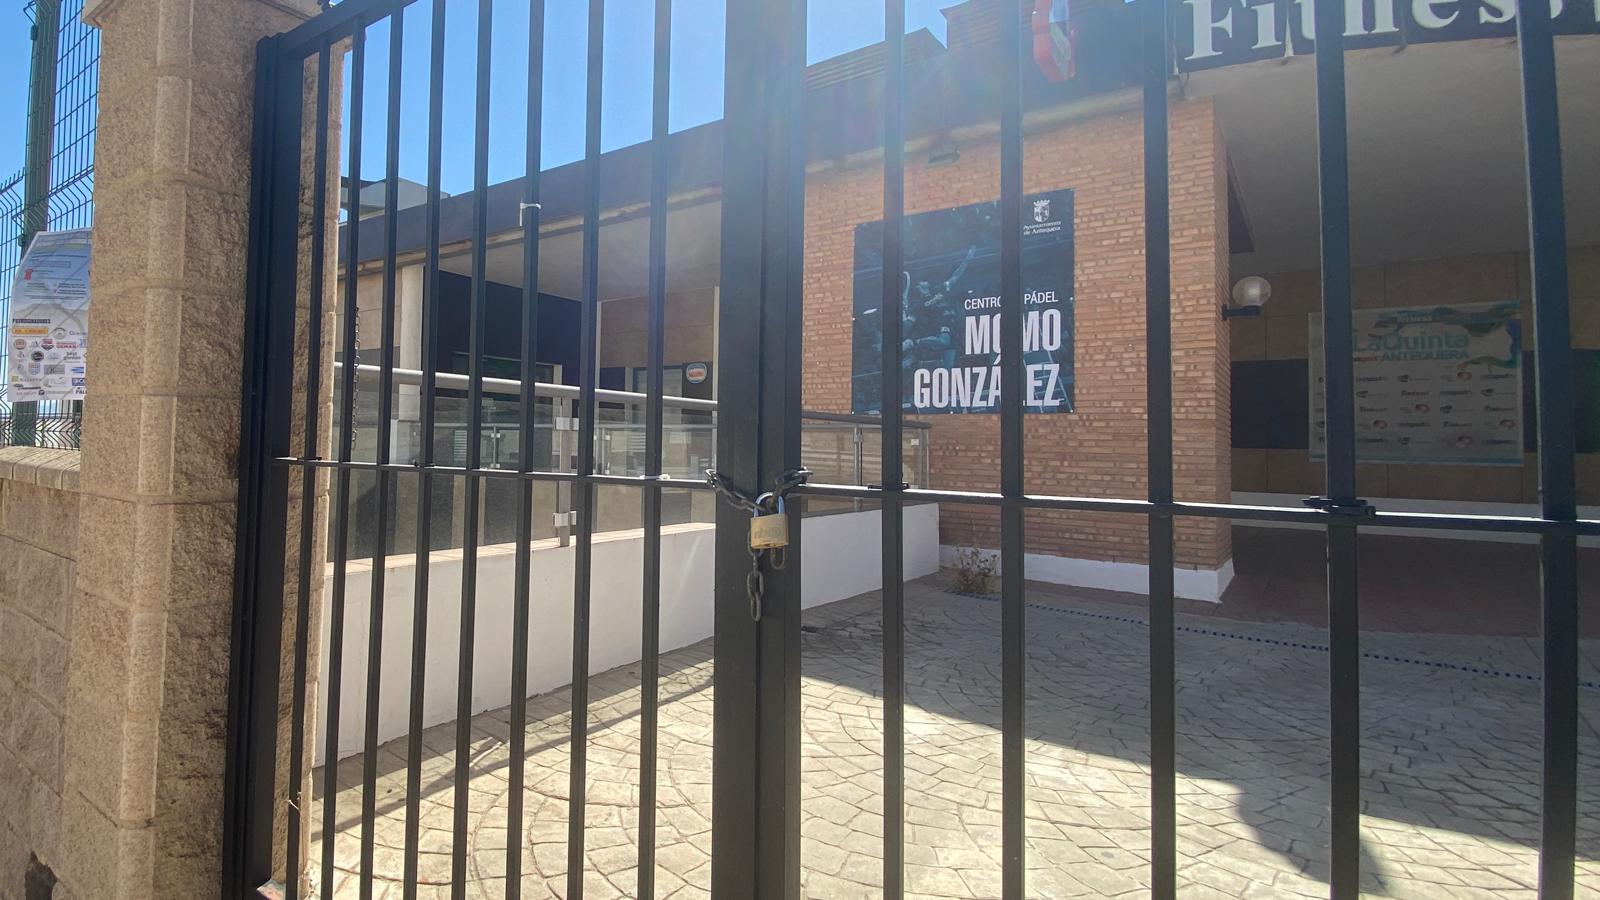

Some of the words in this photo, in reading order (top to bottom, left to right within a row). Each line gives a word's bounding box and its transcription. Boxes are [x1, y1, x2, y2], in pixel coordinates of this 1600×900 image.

[1024, 290, 1059, 304] PÁDEL
[1382, 350, 1470, 361] ANTEQUERA
[914, 355, 1060, 408] GONZÁEZ
